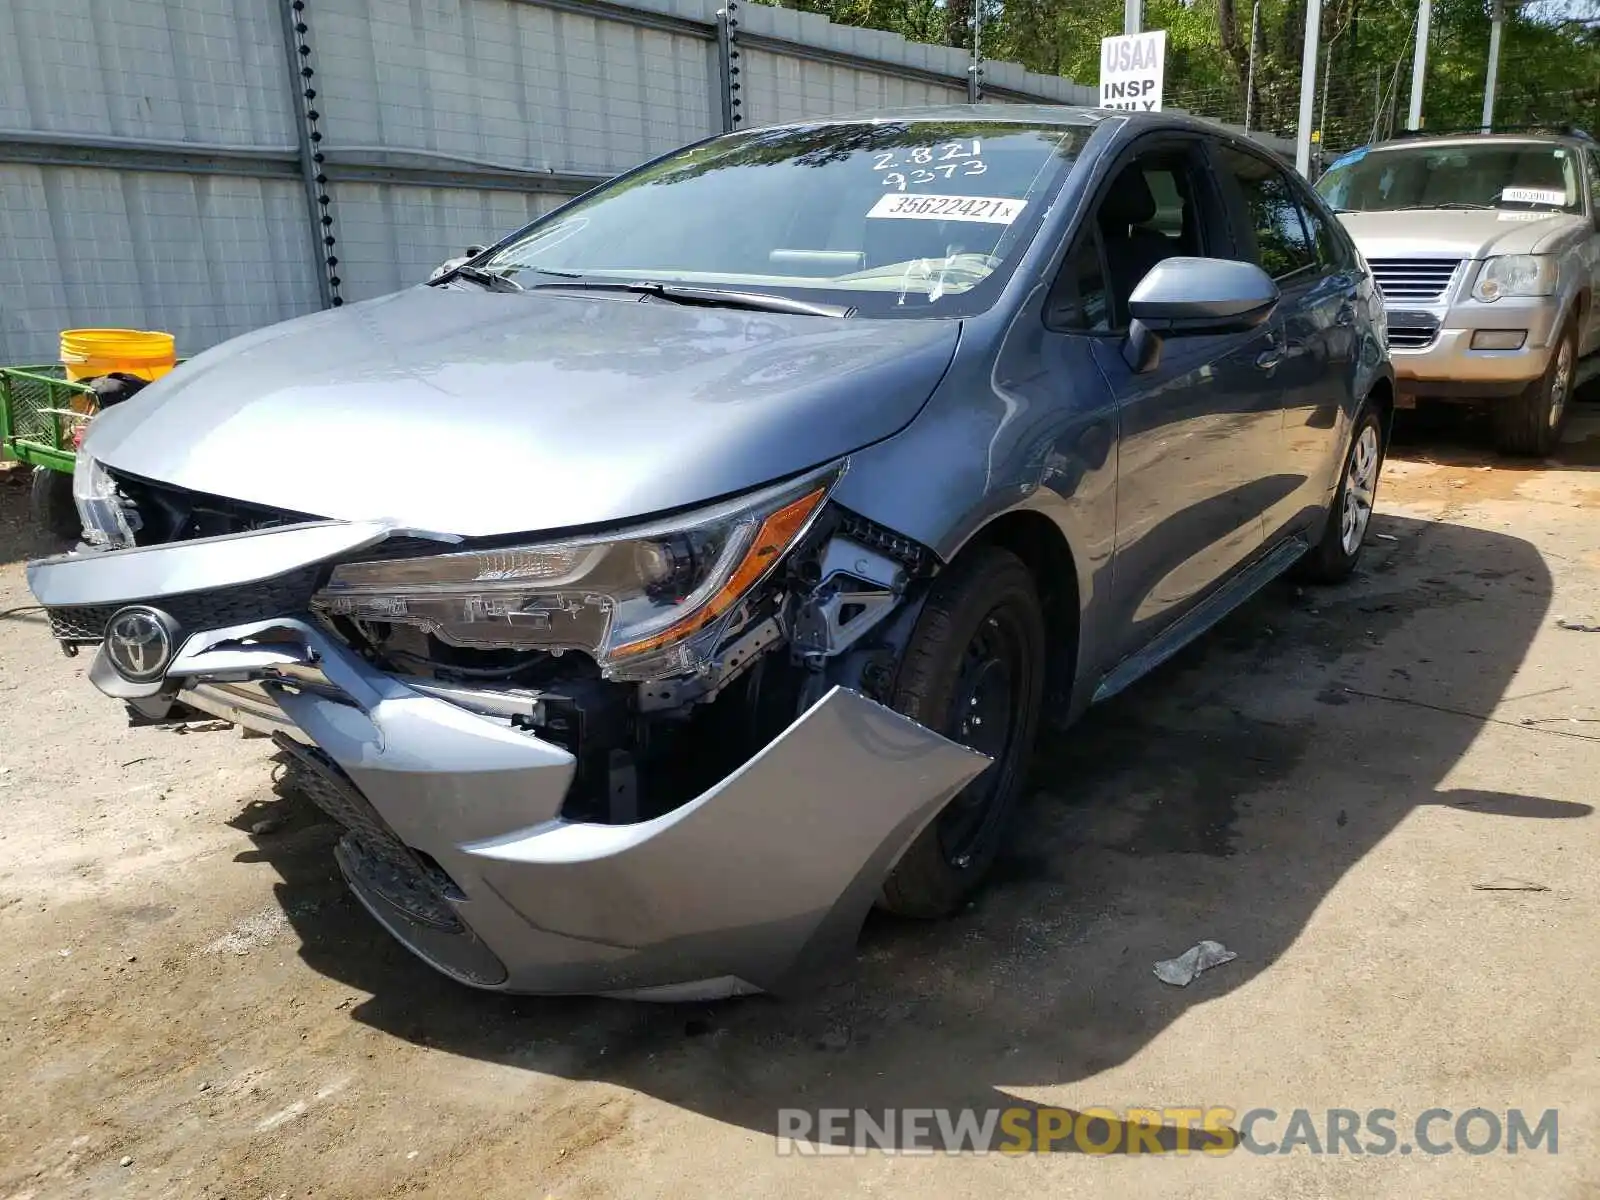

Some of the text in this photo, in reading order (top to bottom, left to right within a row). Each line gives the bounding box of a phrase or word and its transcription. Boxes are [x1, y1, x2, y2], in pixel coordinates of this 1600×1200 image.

[1106, 38, 1157, 73] USAA
[1104, 79, 1155, 99] INSP
[1104, 100, 1156, 112] LY
[882, 160, 988, 191] 9373
